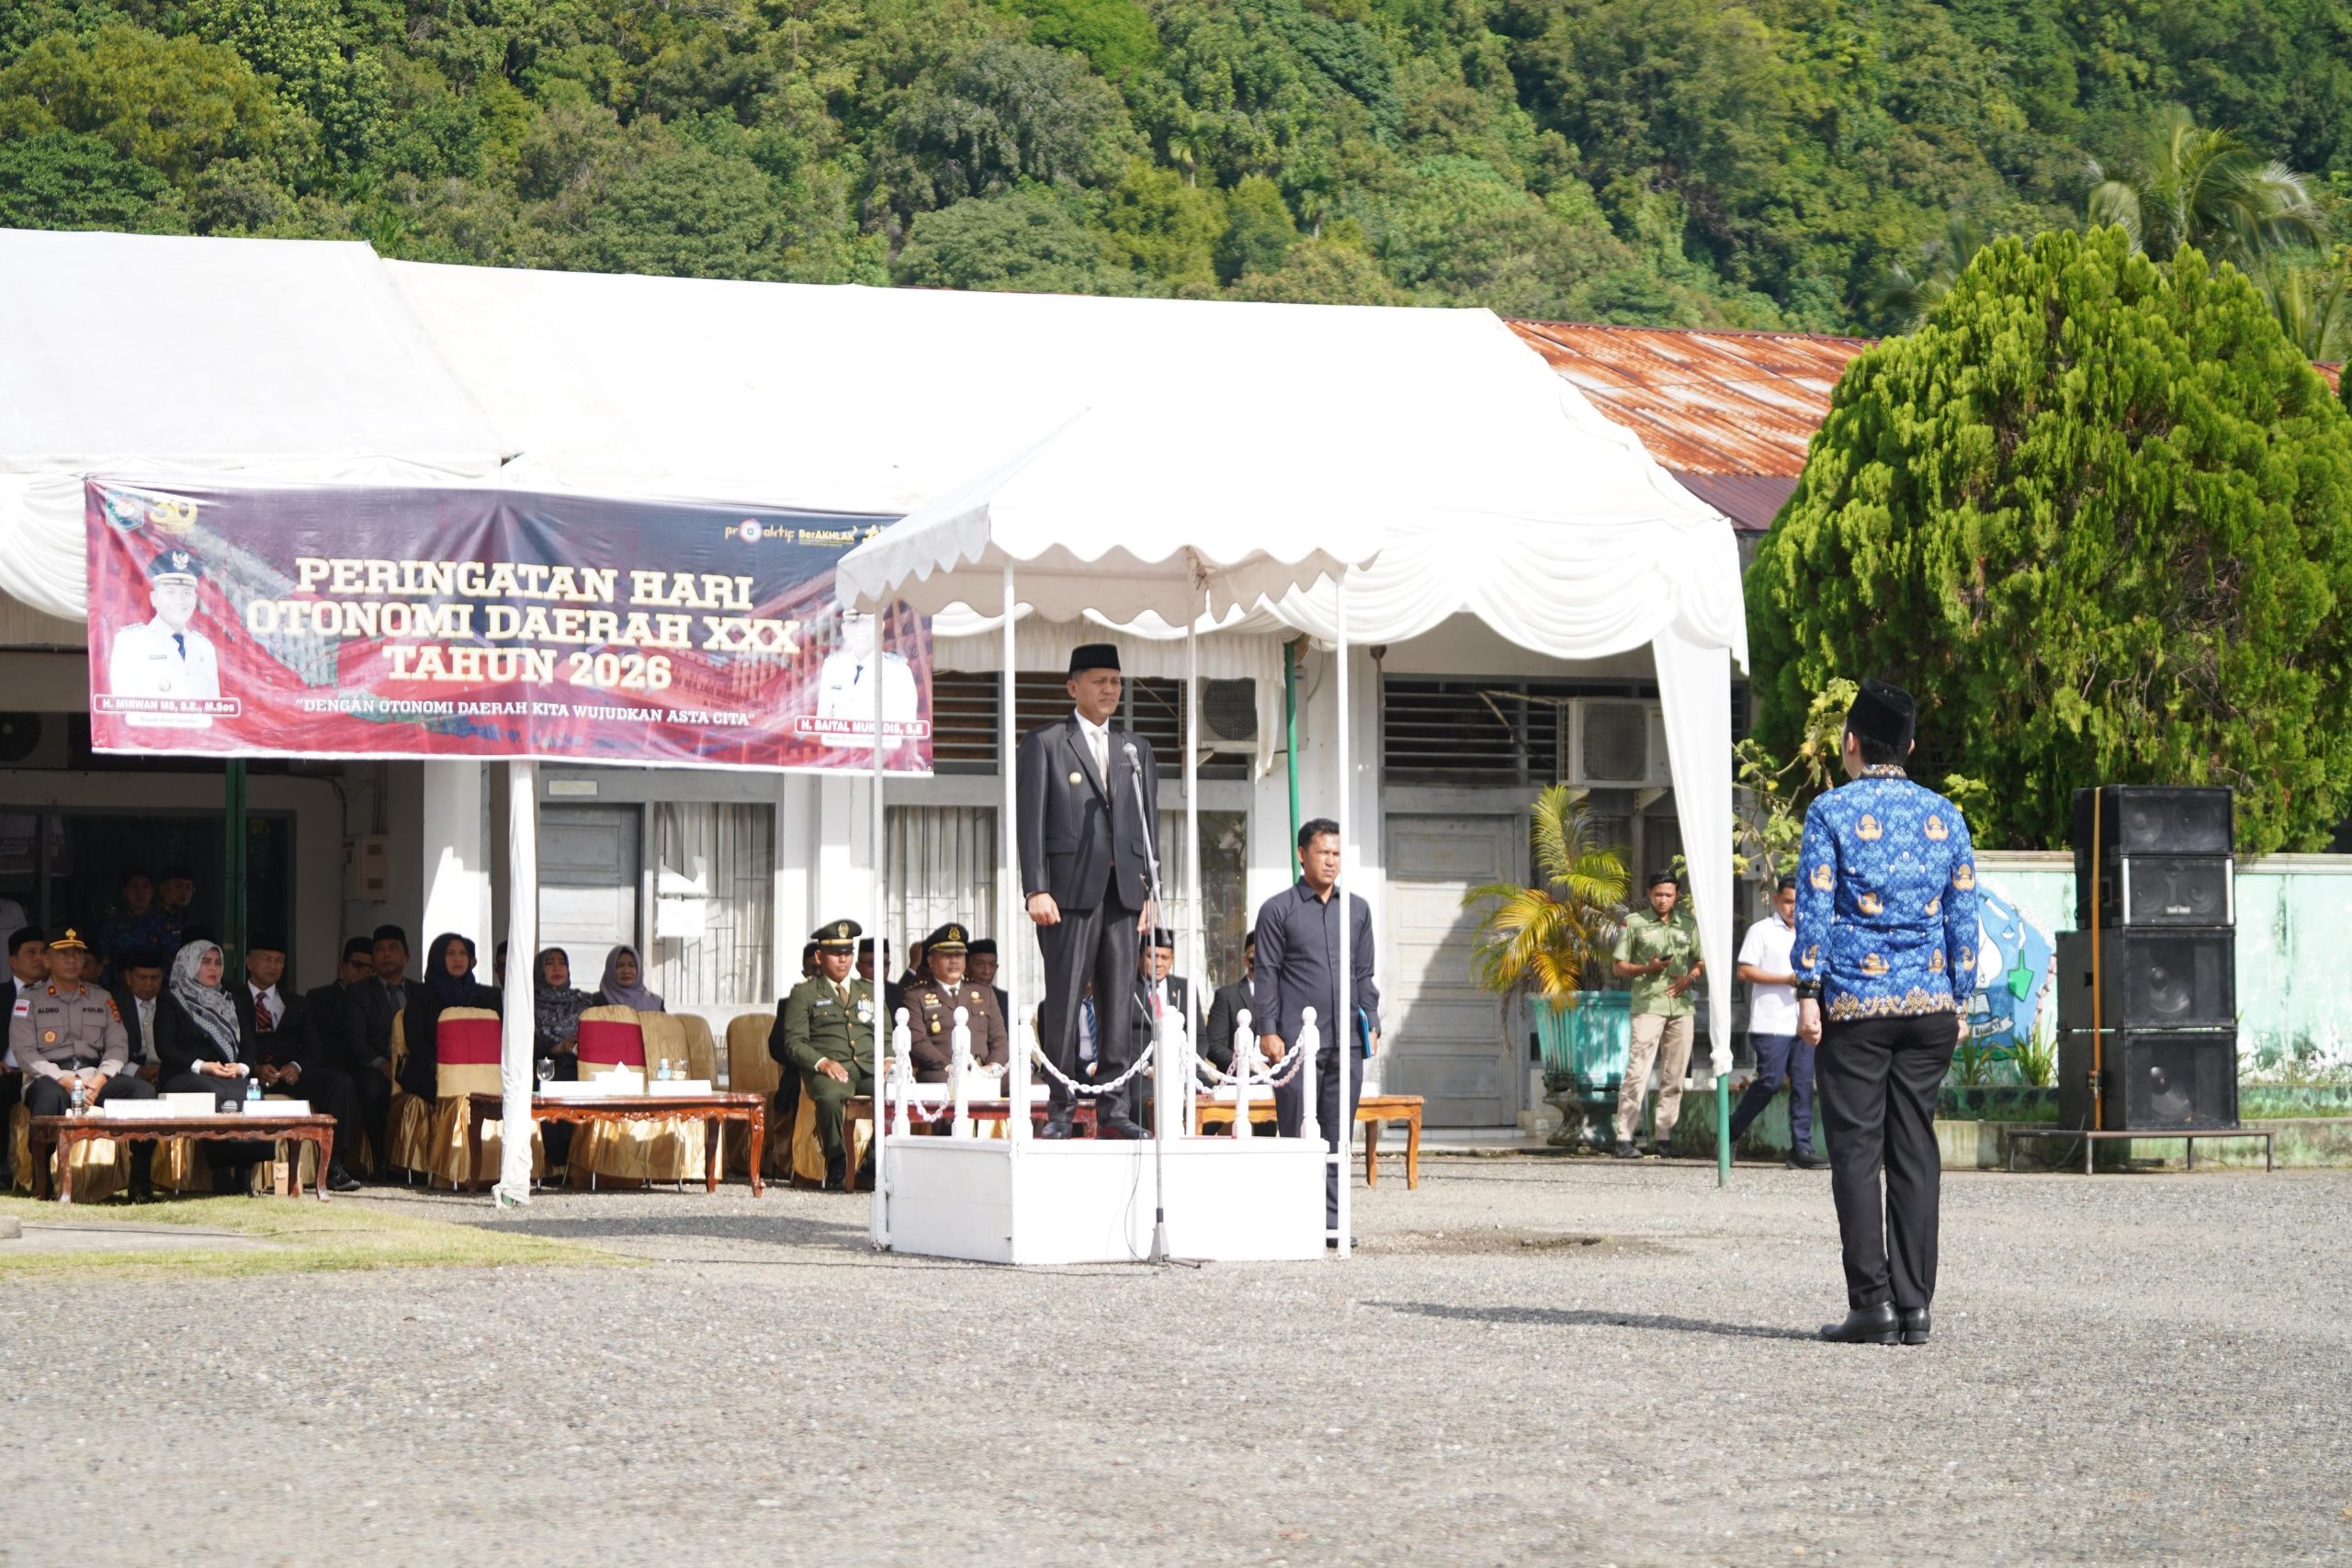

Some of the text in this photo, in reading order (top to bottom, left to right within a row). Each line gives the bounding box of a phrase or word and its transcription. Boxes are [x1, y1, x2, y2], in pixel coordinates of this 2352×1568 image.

[798, 528, 854, 541] BerAKHLAK
[295, 558, 753, 610] PERINGATAN HARI
[246, 600, 800, 654] OTONOMI DAERAH XXX
[382, 645, 673, 689] TAHUN 2026
[102, 699, 113, 709] H.
[116, 699, 158, 710] MIRWAN
[205, 703, 234, 713] M.Sos
[379, 700, 455, 714] OTONOMI
[458, 701, 527, 715] DAERAH
[532, 703, 570, 716] KITA
[573, 705, 663, 722] WUJUDKAN
[668, 711, 709, 725] ASTA
[801, 718, 812, 730] H.
[815, 719, 850, 731] BAITAL
[853, 721, 903, 734] MUKDIS,
